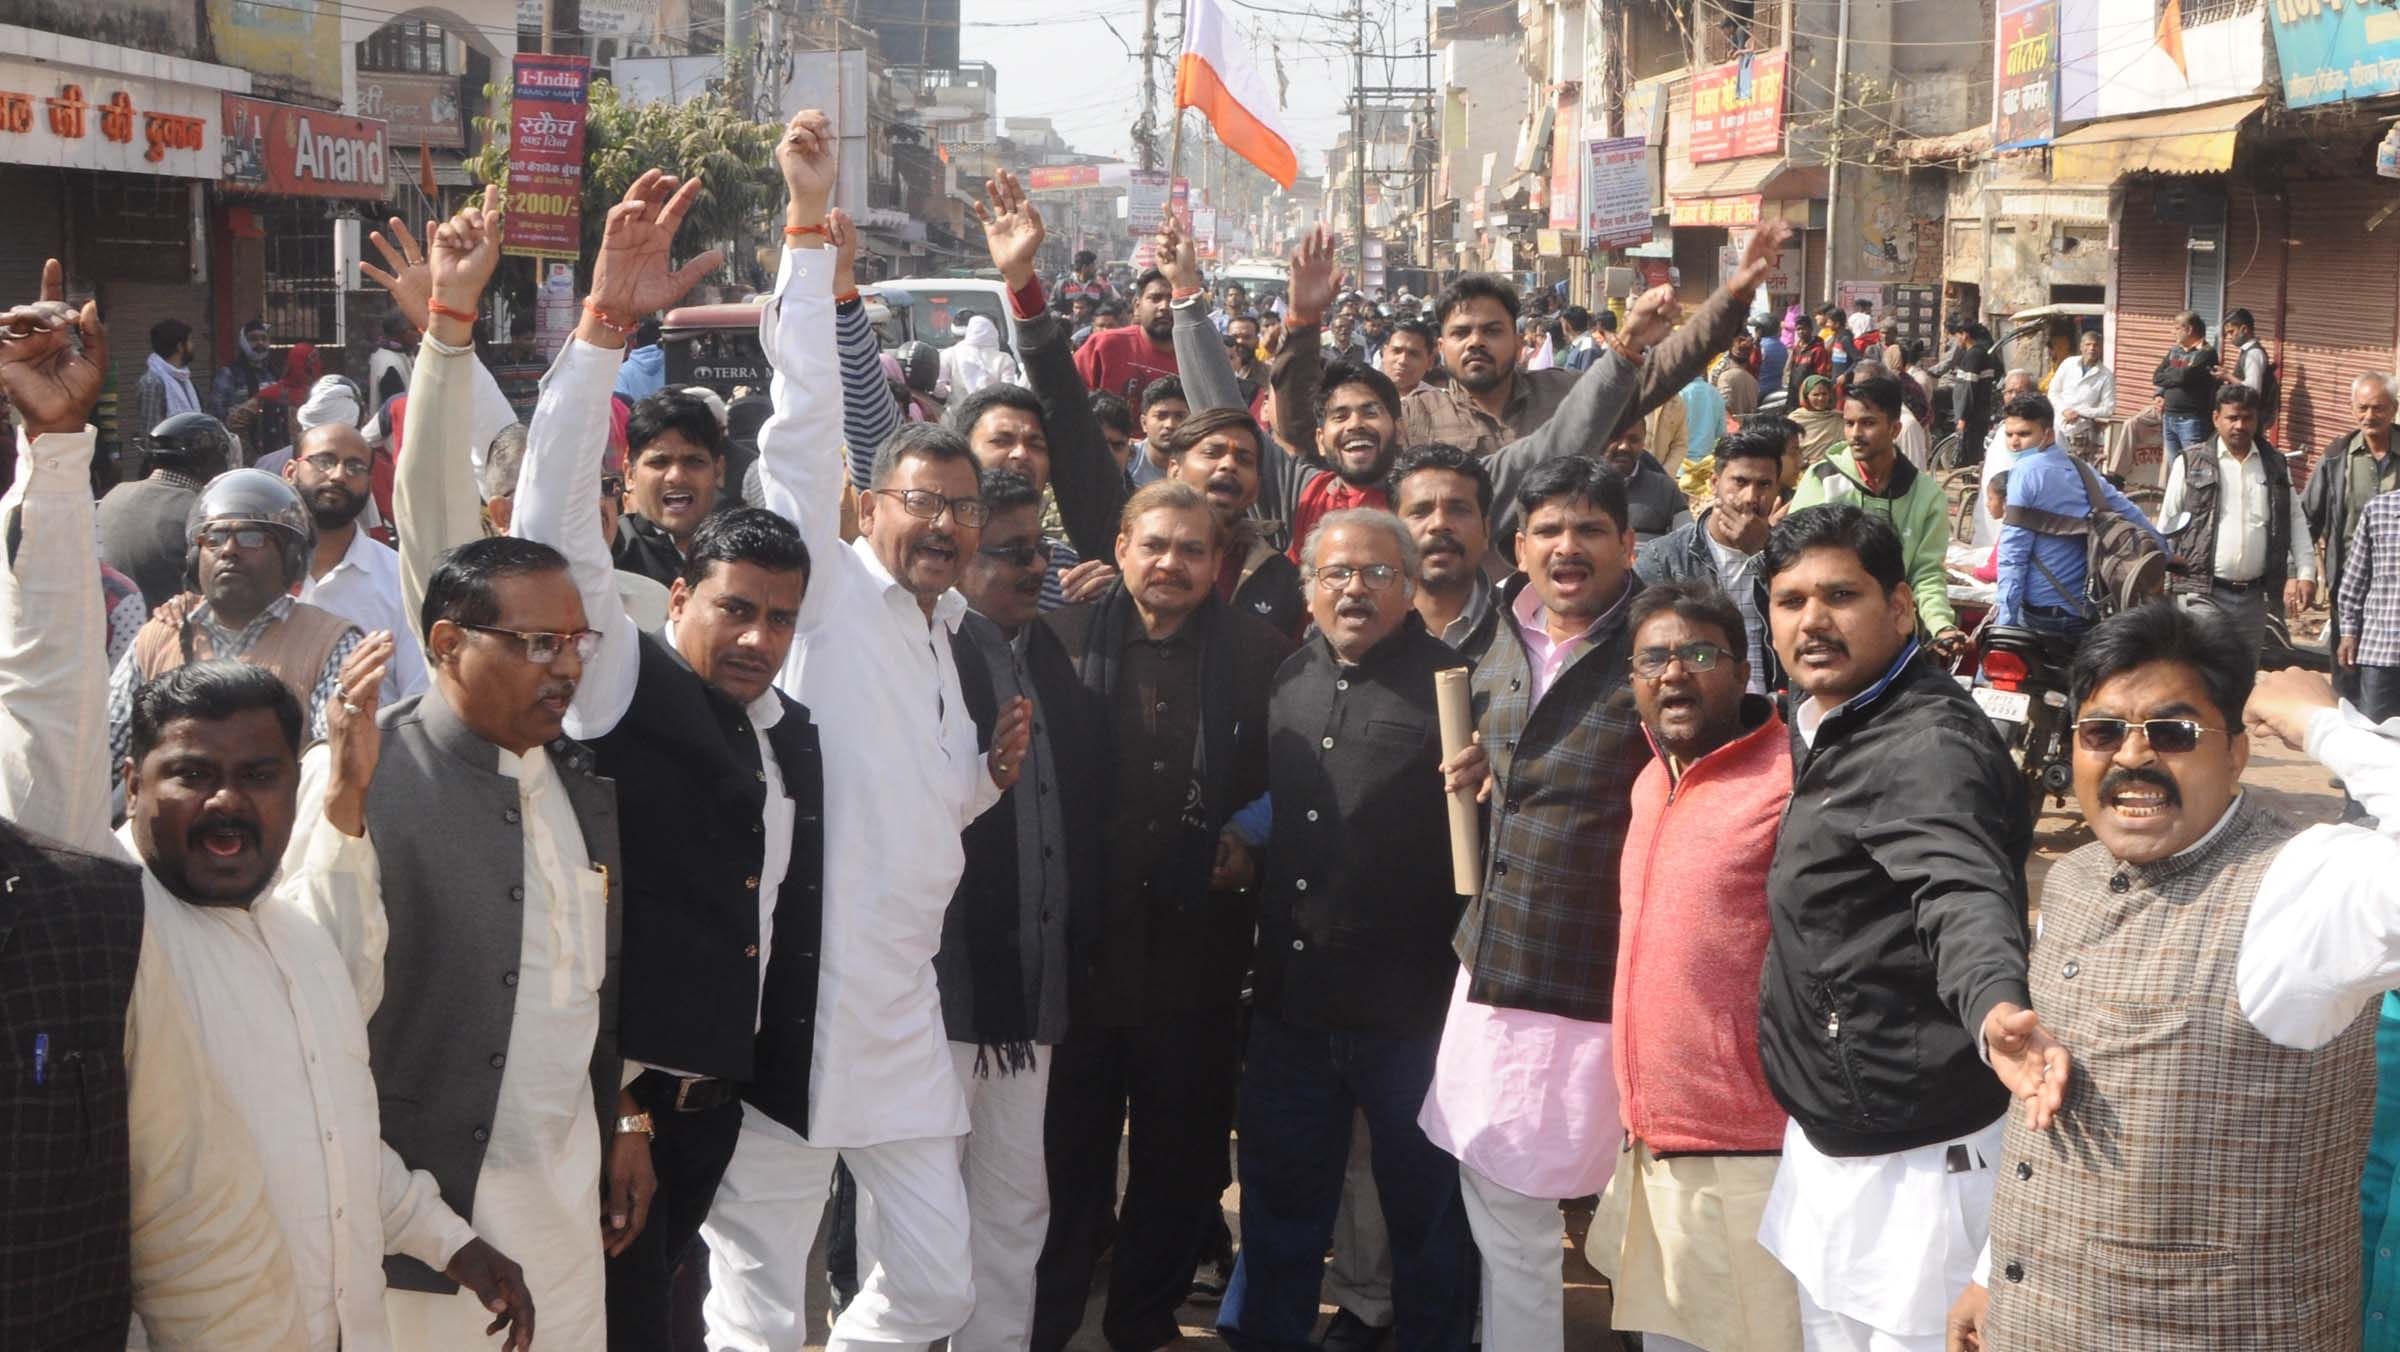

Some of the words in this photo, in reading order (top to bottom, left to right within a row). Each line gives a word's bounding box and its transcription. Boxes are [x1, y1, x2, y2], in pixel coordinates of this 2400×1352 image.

[46, 84, 91, 139] जी
[98, 91, 137, 144] की
[143, 111, 206, 162] दुकान
[295, 117, 385, 184] Anand
[713, 367, 758, 379] TERRA
